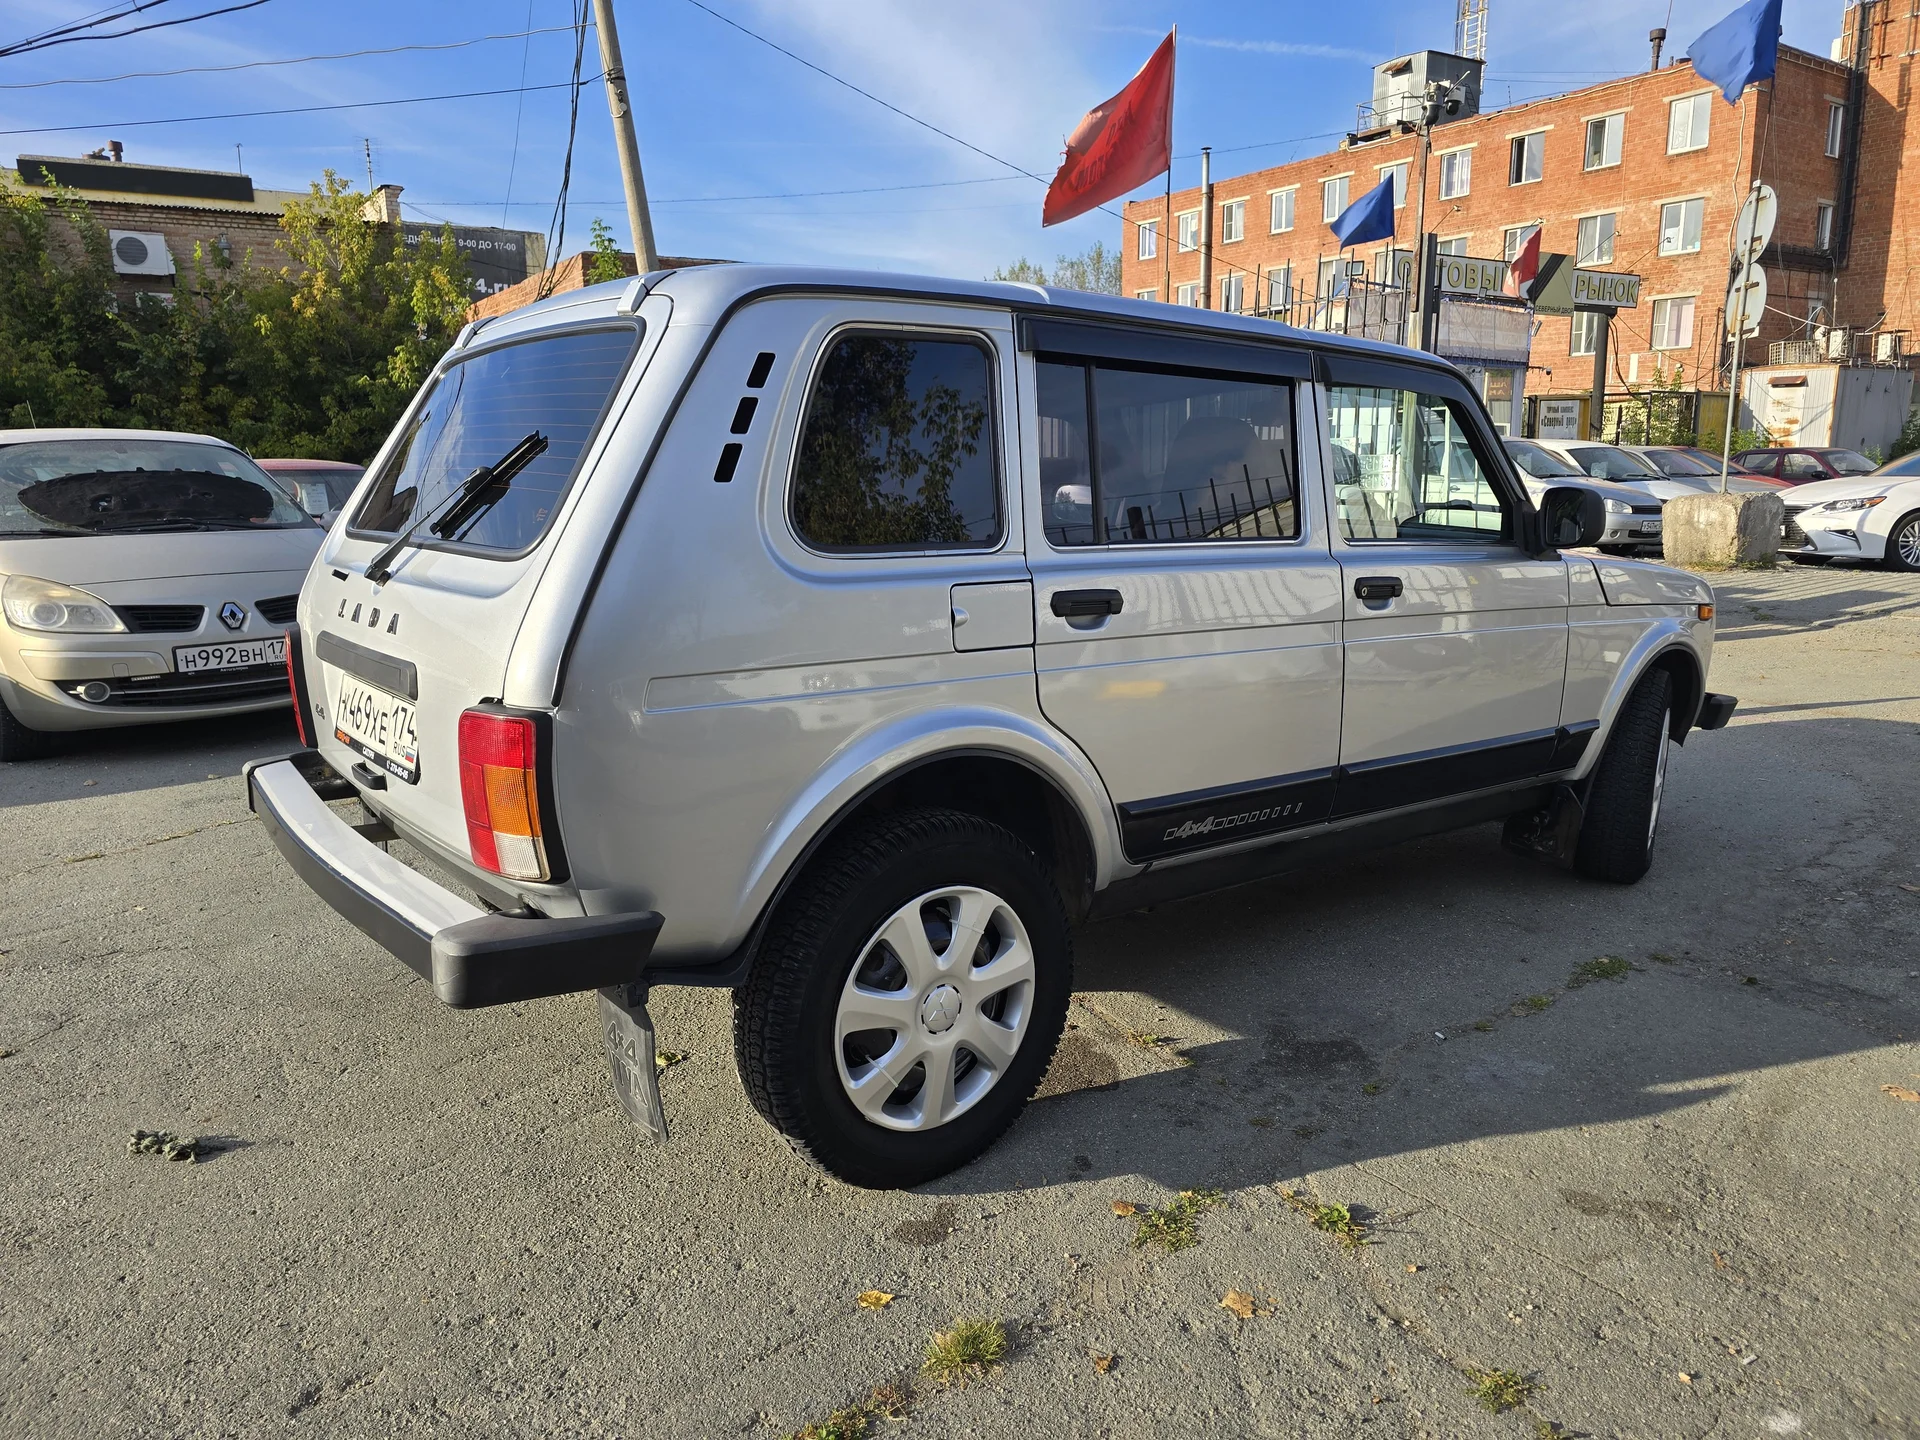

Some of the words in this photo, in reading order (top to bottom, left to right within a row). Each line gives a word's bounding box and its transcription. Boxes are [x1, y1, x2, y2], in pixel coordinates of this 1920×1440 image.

[458, 238, 477, 248] 9-00
[478, 240, 492, 250] ДО
[494, 241, 517, 252] 17-00
[1397, 256, 1510, 292] ОТОВЫ
[1575, 274, 1638, 304] РЫНОК
[1535, 305, 1561, 313] СЕВЕРНЫЙ
[337, 598, 400, 636] LADA
[184, 646, 264, 669] Н992ВН
[267, 640, 285, 655] 17
[392, 705, 415, 746] 174
[392, 741, 406, 758] RUS
[1175, 816, 1215, 839] 4x4
